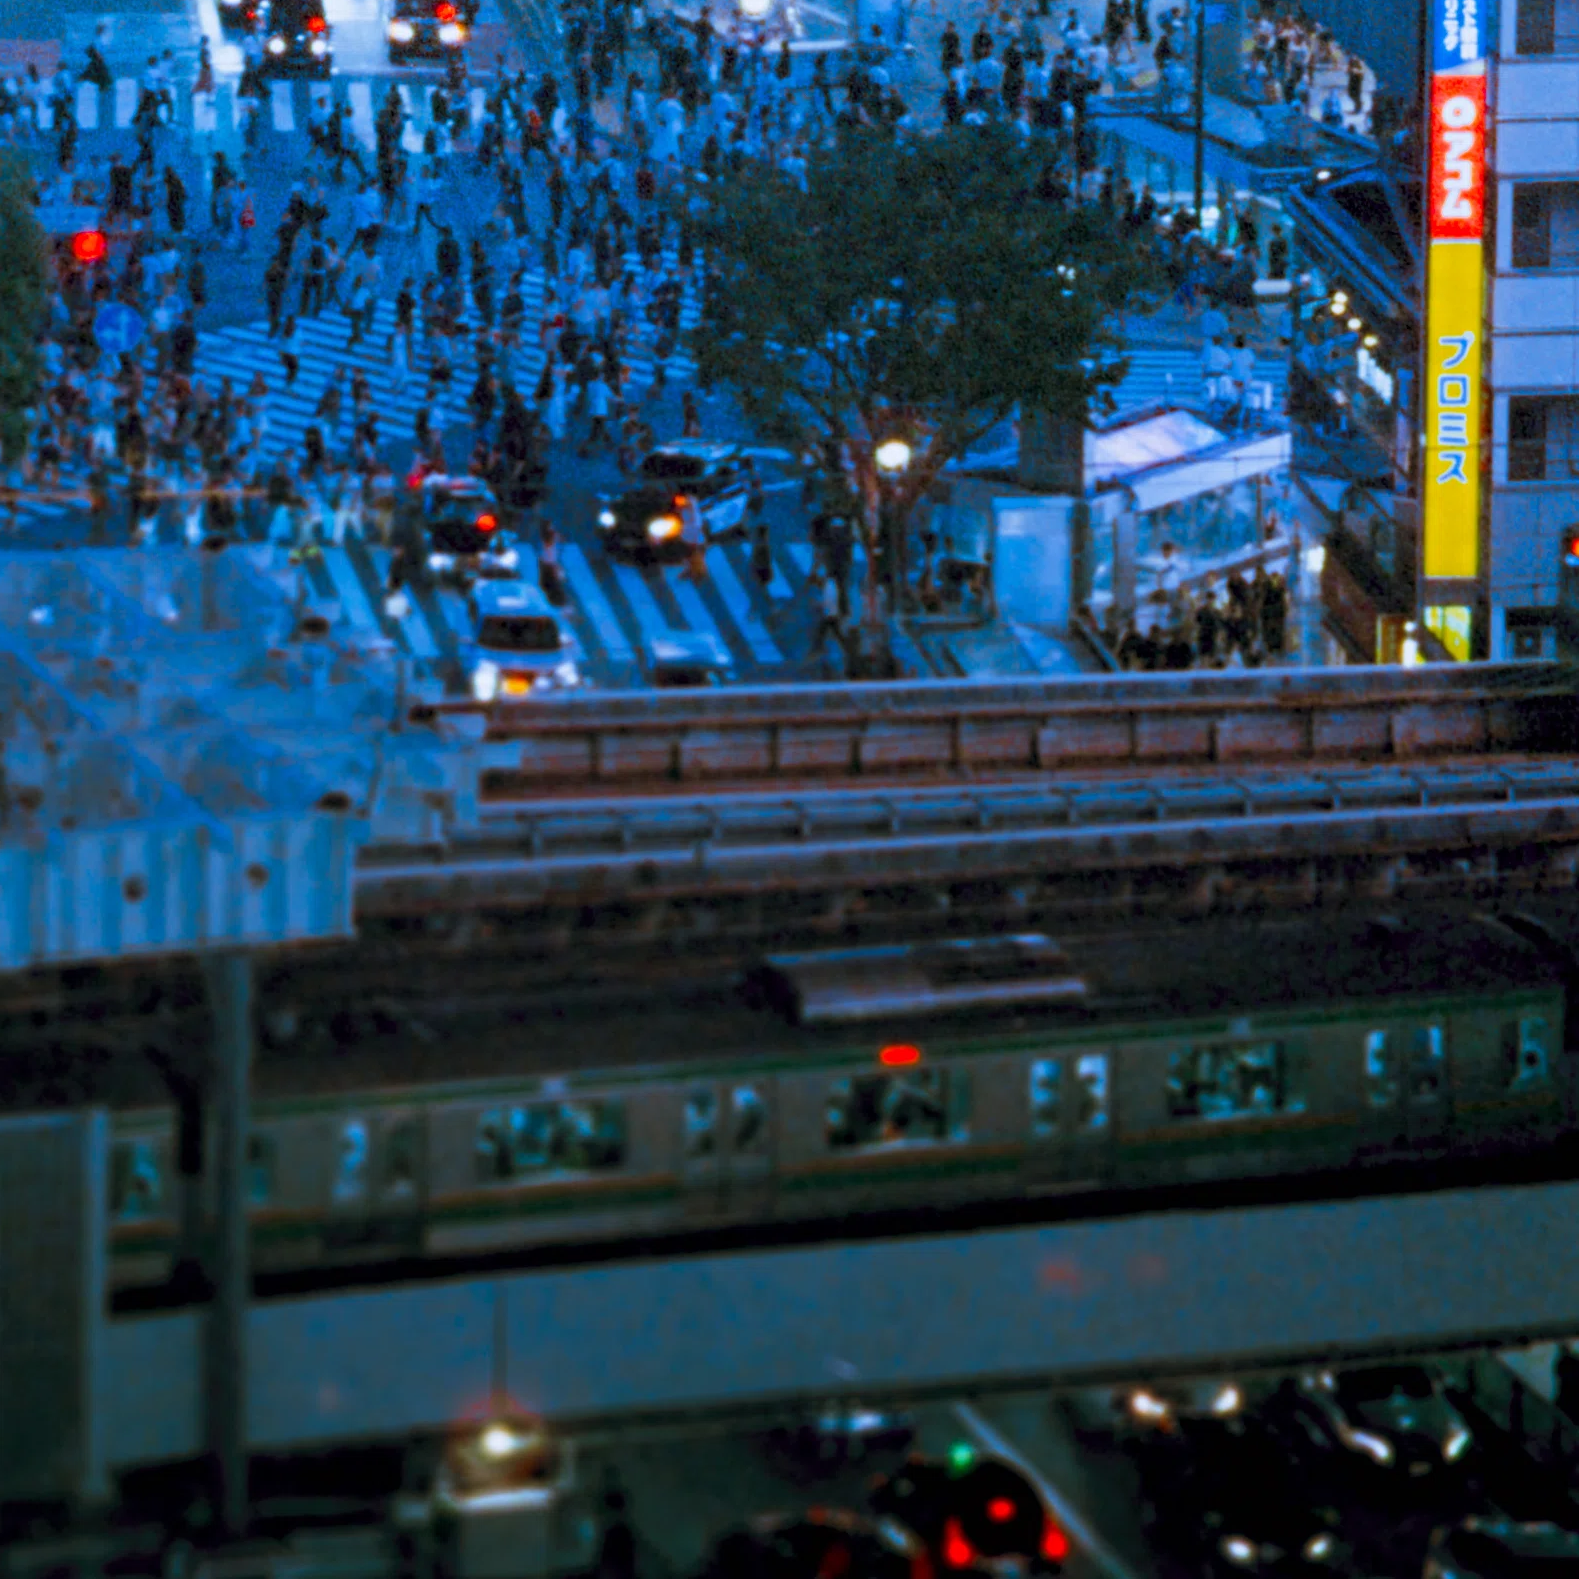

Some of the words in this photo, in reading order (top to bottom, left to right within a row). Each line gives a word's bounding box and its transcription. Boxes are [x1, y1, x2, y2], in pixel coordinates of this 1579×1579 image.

[1437, 131, 1475, 220] アコム
[1436, 330, 1476, 488] プロミス
